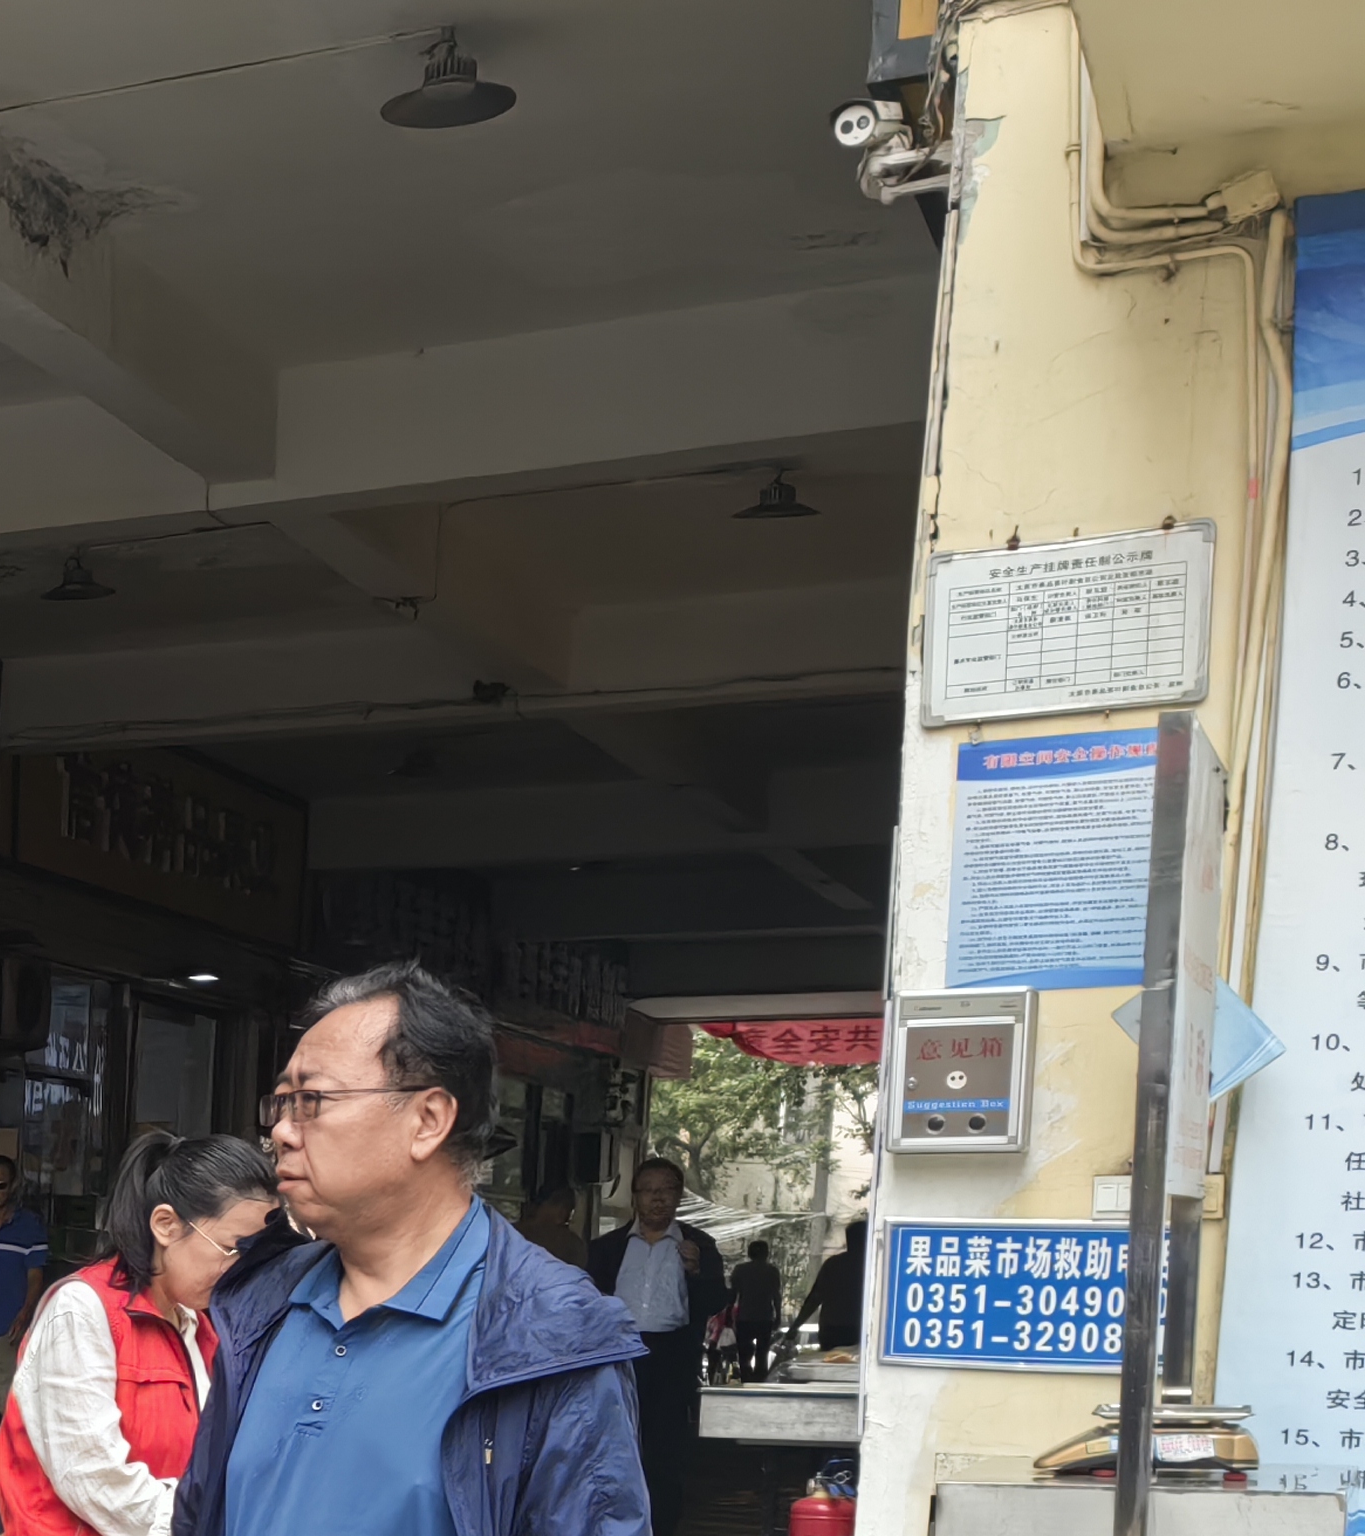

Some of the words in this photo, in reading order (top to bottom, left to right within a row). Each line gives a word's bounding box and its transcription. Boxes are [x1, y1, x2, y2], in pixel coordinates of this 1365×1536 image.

[989, 550, 1154, 580] 安全生产挂牌责任制公示牌
[916, 1036, 1004, 1062] 意见箱
[1340, 1190, 1365, 1212] 社
[905, 1234, 1172, 1281] 果品菜市场救助
[905, 1282, 1168, 1317] 0351-30490
[1331, 1309, 1365, 1331] 定
[903, 1318, 1165, 1354] 0351-32908
